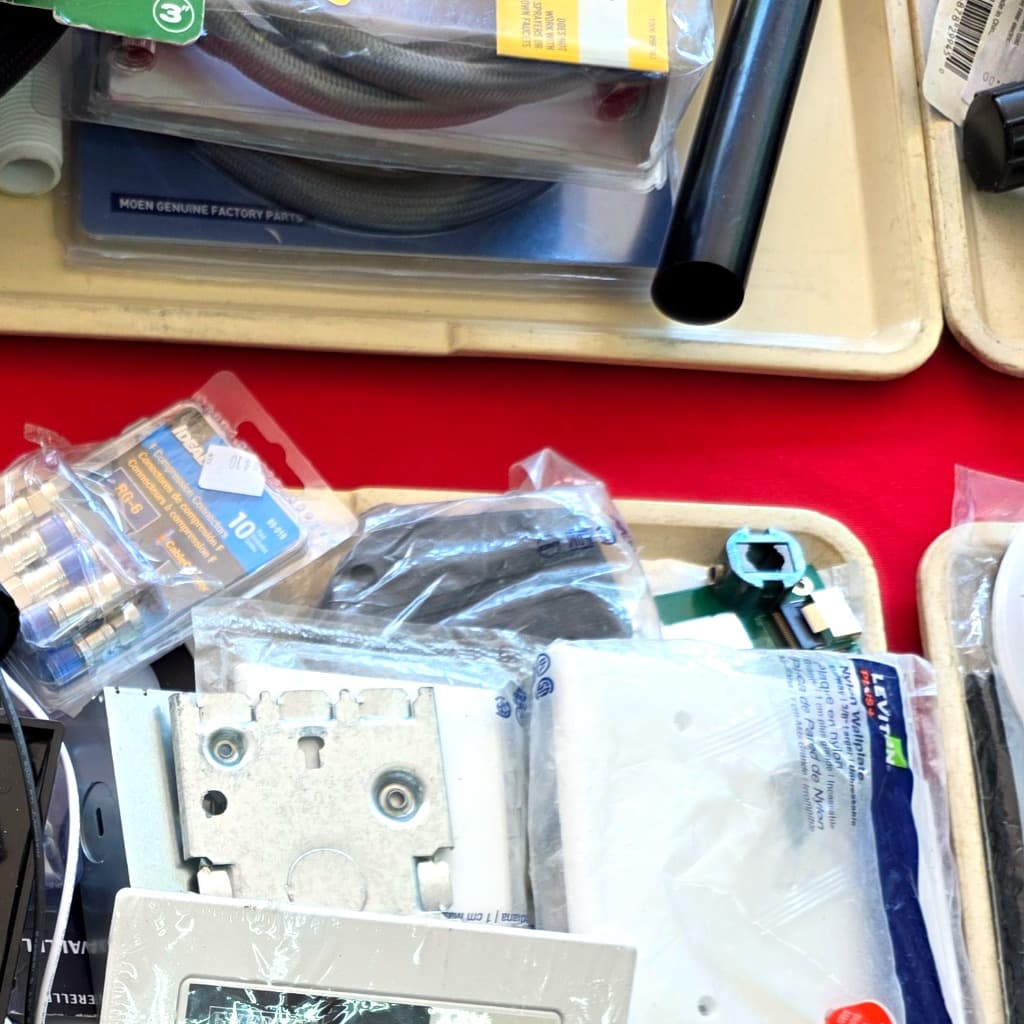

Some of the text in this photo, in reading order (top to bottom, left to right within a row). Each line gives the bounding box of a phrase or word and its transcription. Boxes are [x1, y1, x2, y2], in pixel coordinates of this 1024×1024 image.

[119, 198, 304, 223] MOEN GENUINE FACTORY PARTS
[113, 481, 144, 517] RG-6
[225, 509, 258, 542] 10
[851, 711, 866, 781] Wallplate
